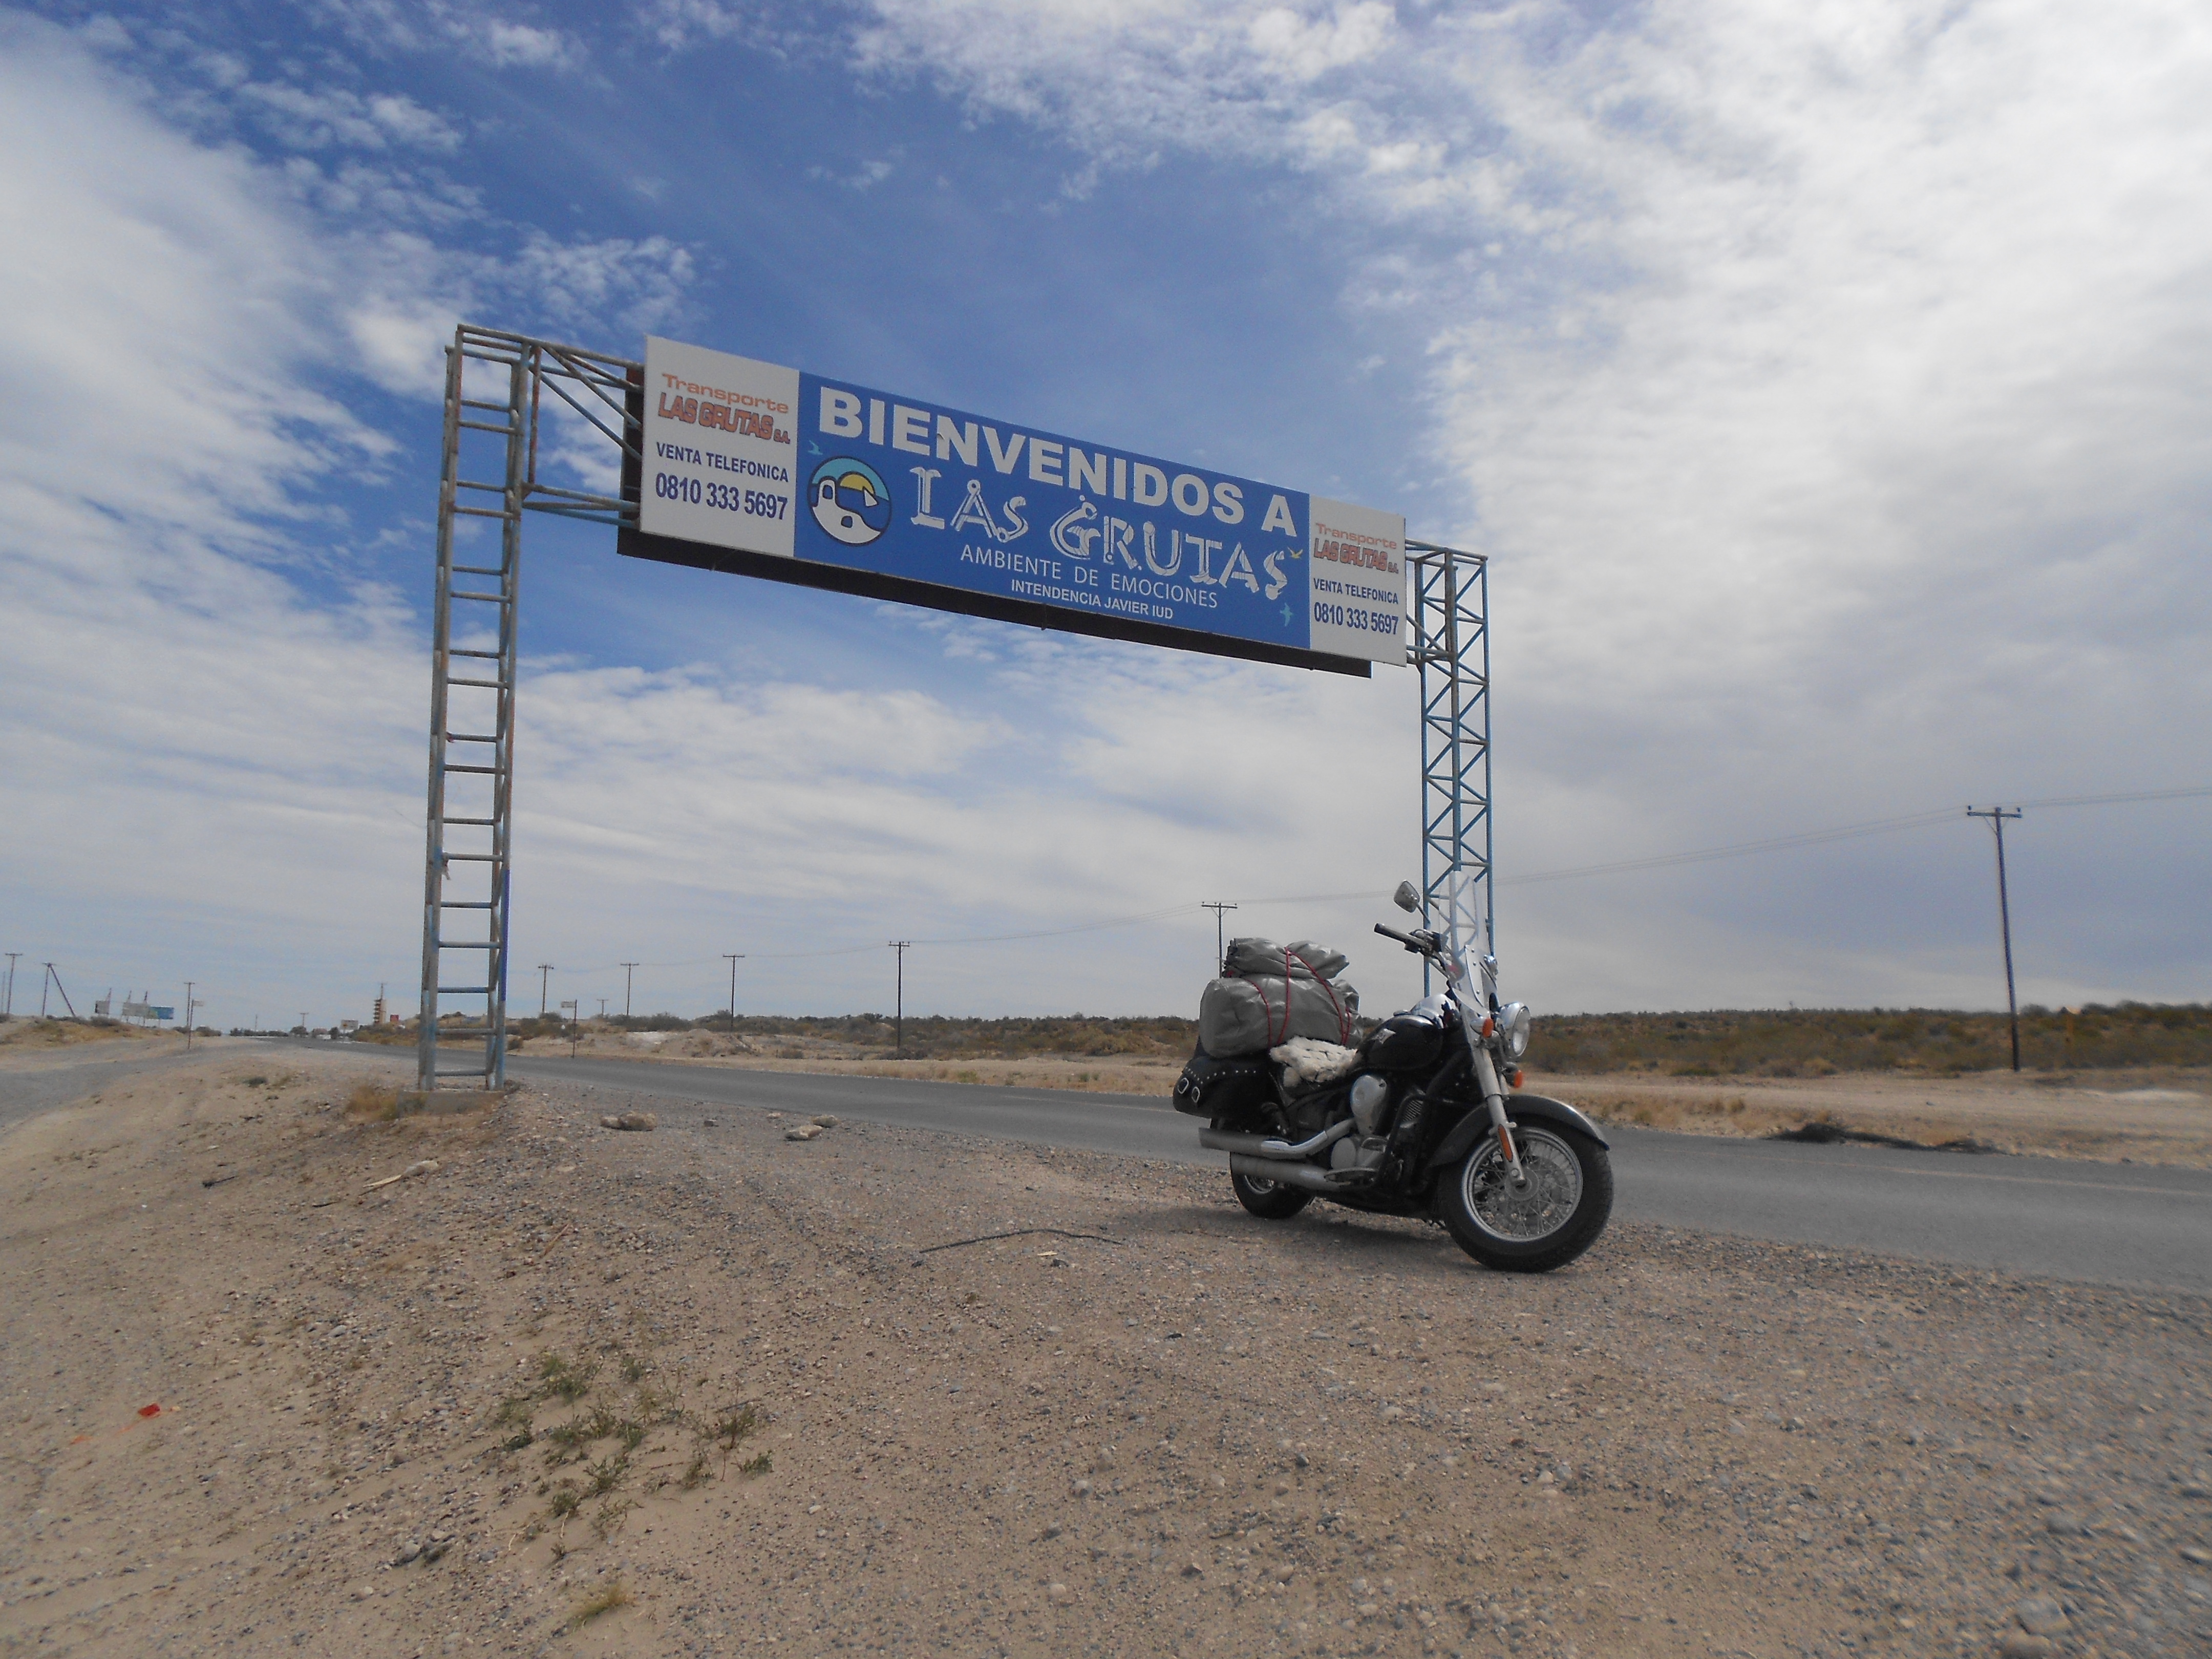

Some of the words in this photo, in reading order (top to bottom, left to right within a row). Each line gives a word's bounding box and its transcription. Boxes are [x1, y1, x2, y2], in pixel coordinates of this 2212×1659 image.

[662, 373, 789, 413] Transporte
[658, 392, 698, 424] LAS
[698, 401, 774, 440] GRUTAS
[656, 442, 701, 465] VENTA
[706, 452, 789, 482] TELEFONICA
[820, 387, 1244, 524] BIENVENIDOS
[1261, 495, 1297, 537] A
[655, 473, 701, 504] 0810
[706, 482, 739, 512] 333
[744, 490, 788, 520] 5697
[910, 467, 1028, 543] LAS
[1050, 495, 1288, 600] GRUTAS
[1316, 523, 1397, 549] Transporte
[1314, 538, 1339, 562] LAS
[1340, 543, 1388, 571] GRUTAS
[961, 544, 1061, 579] AMBIENTE
[1075, 566, 1098, 586] DE
[1112, 574, 1218, 608] EMOCIONES
[1313, 578, 1343, 594] VENTA
[1345, 584, 1398, 604] TELEFONICA
[1011, 579, 1101, 606] INTENDENCIA
[1104, 597, 1148, 616] JAVIER
[1152, 605, 1174, 619] IUD
[1314, 602, 1344, 626] 0810
[1347, 607, 1368, 630] 333
[1371, 612, 1398, 634] 5697
